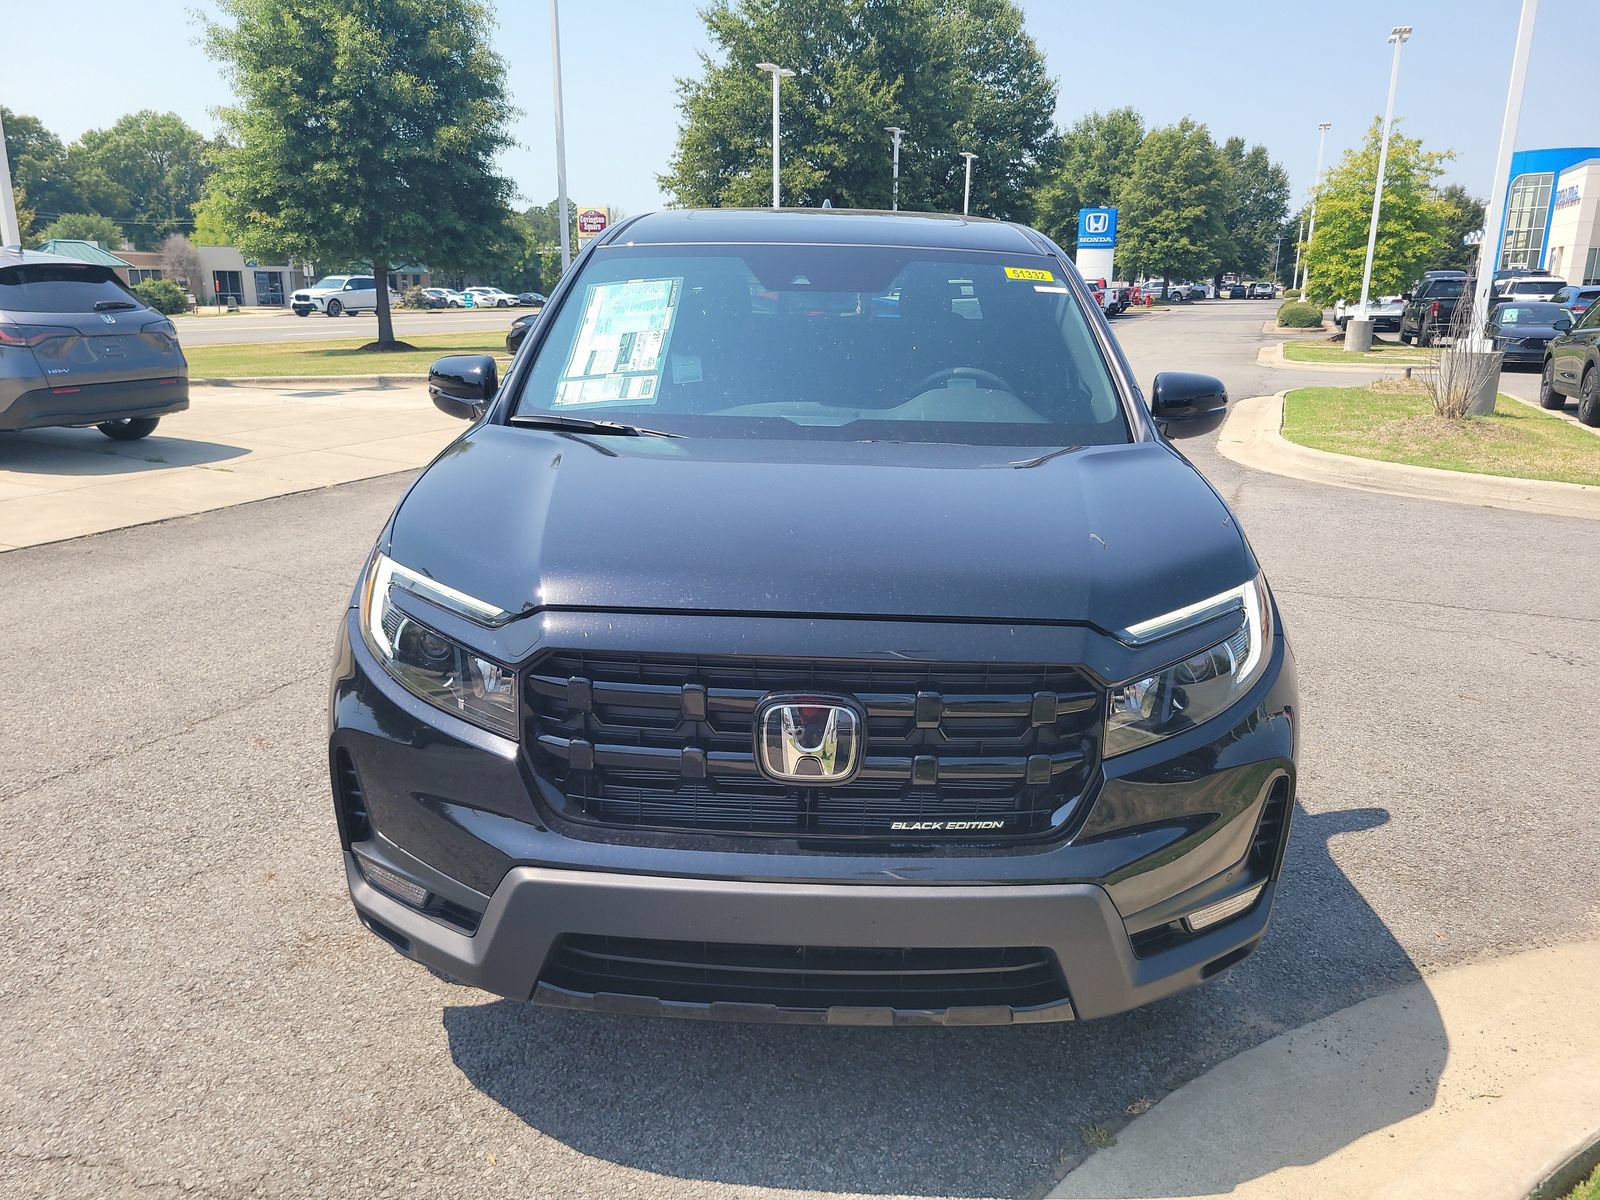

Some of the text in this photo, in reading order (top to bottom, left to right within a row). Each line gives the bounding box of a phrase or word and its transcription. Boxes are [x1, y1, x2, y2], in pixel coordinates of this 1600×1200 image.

[1012, 269, 1046, 280] 51332
[891, 821, 1004, 830] BLACK EDITION
